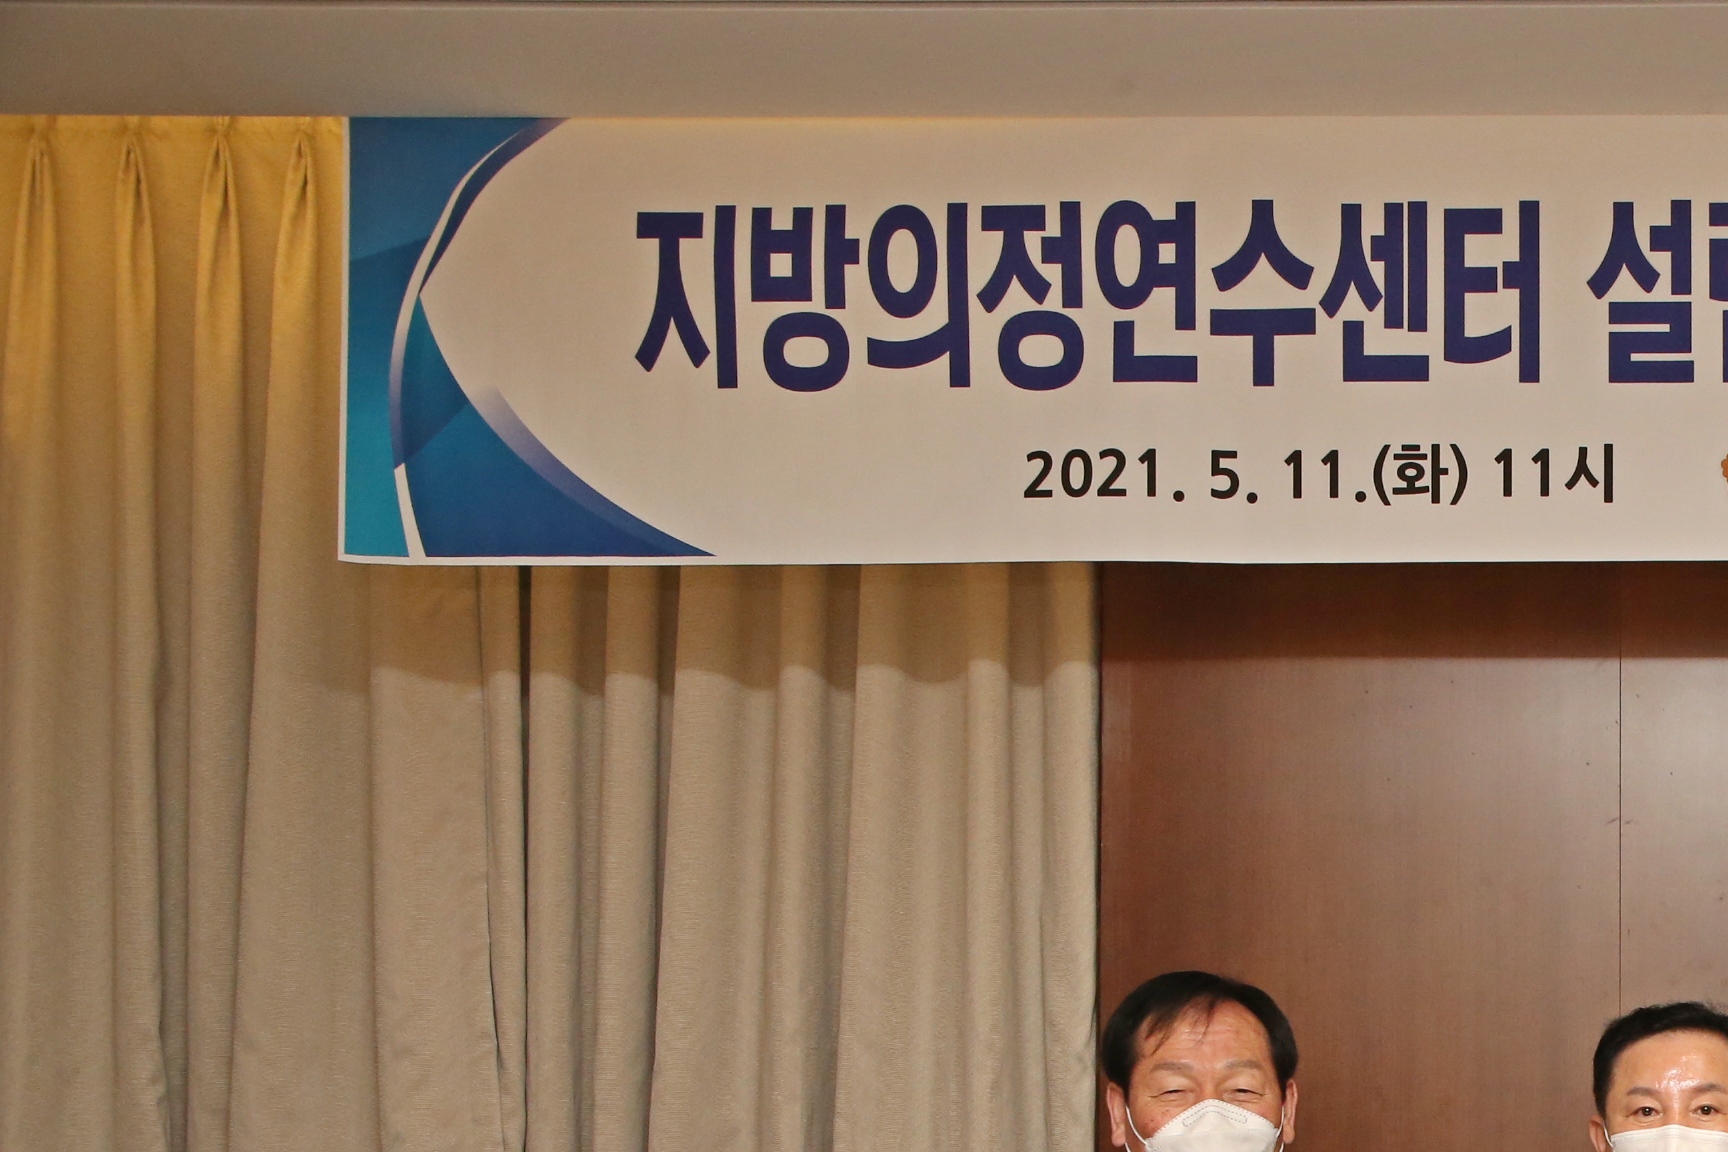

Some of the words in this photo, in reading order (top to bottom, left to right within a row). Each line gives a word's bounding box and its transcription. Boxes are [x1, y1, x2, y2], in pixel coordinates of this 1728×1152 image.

[634, 199, 1541, 393] 지방의정연수센터
[1023, 447, 1185, 503] 2021.
[1210, 449, 1258, 505] 5.
[1283, 443, 1468, 507] 11.(화)
[1494, 443, 1614, 504] 11시
